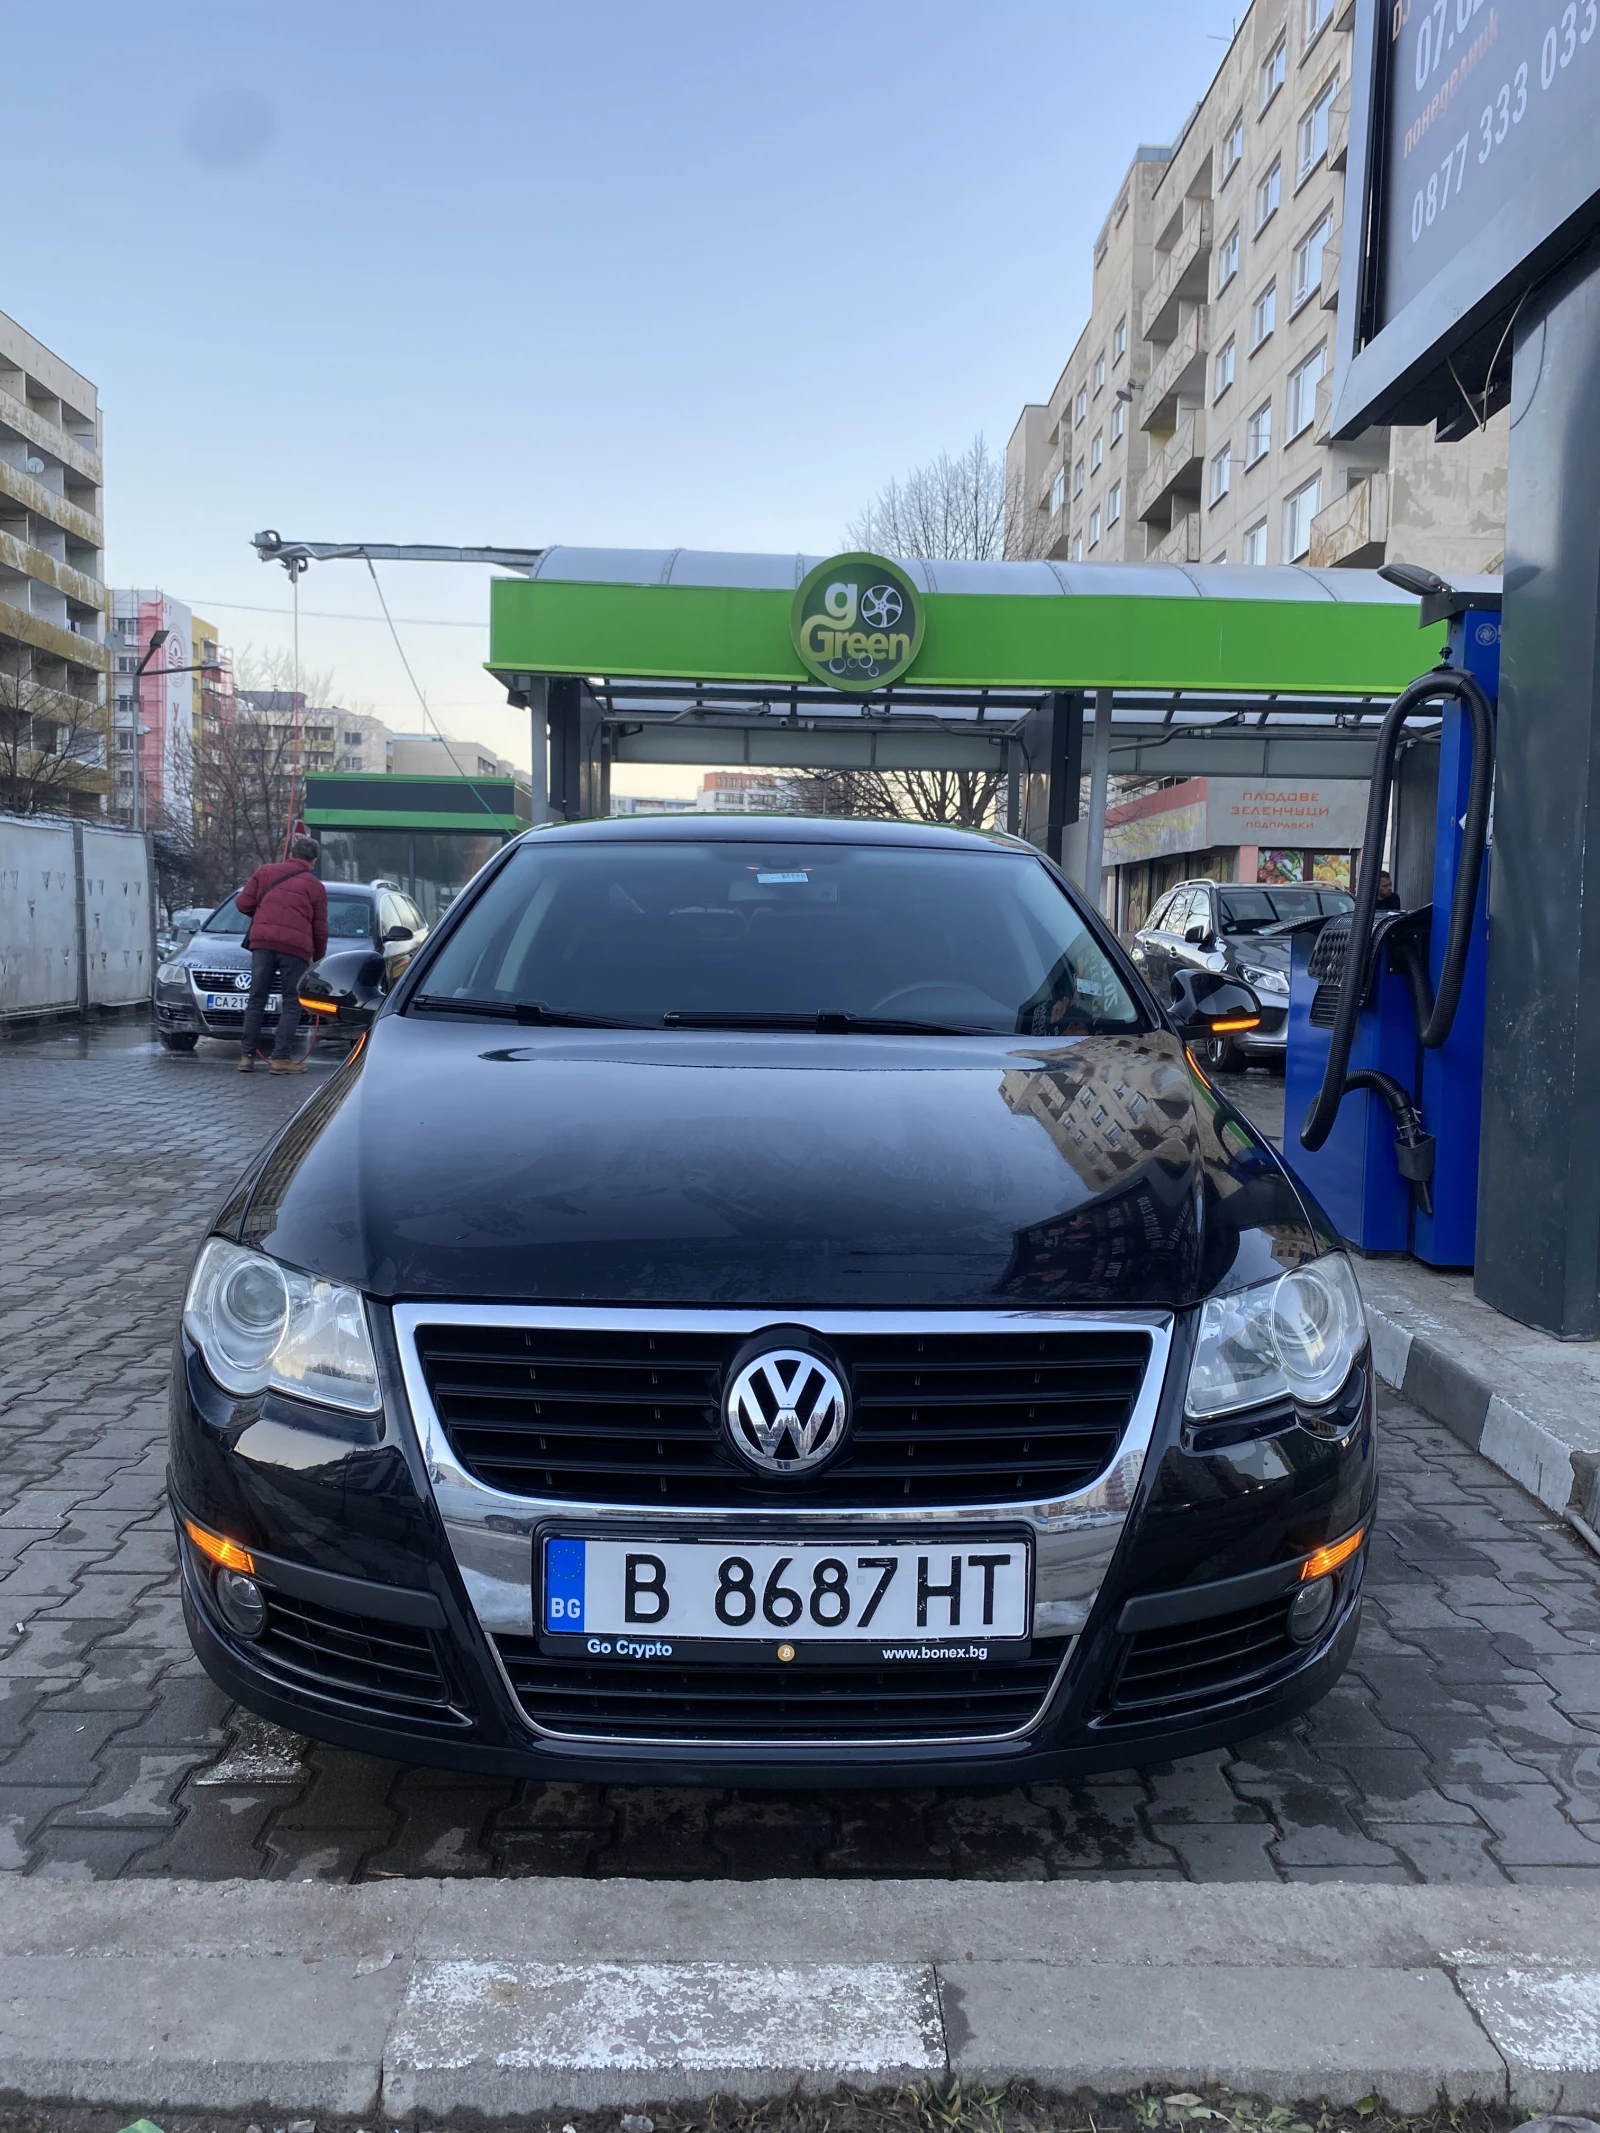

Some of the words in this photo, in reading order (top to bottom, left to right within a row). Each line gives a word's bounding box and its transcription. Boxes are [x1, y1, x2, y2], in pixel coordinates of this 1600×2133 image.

[1411, 131, 1470, 243] 0877
[1478, 61, 1528, 164] 333
[1541, 0, 1598, 90] 033
[800, 615, 911, 662] Green
[1231, 807, 1329, 817] ЗЕЛЕНЧУЦИ
[1242, 792, 1319, 802] ПЛОДОВЕ
[551, 1598, 582, 1619] BG
[624, 1552, 670, 1624] B
[713, 1555, 899, 1627] 8687
[916, 1554, 1012, 1627] HT
[587, 1639, 613, 1655] Go
[616, 1640, 673, 1659] Crypto
[882, 1645, 989, 1661] www.bonex.bg
